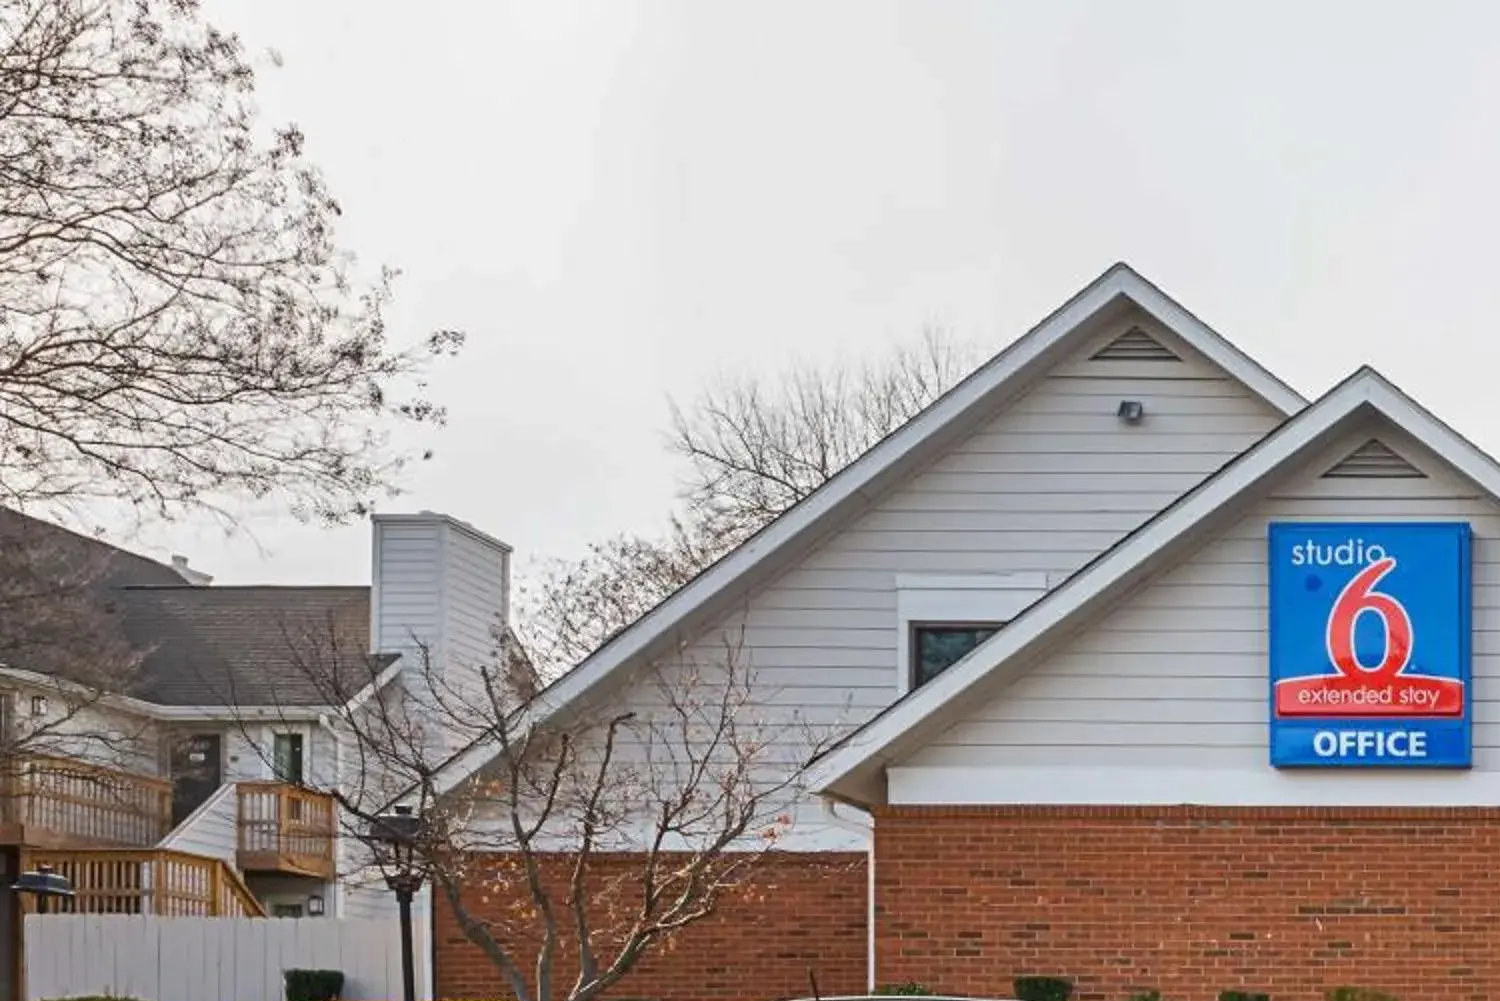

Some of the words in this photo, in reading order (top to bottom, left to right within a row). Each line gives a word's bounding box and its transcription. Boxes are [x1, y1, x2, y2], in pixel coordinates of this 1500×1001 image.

[1291, 539, 1386, 566] studio
[1325, 557, 1414, 676] 6
[1298, 686, 1393, 705] extended
[1399, 686, 1441, 709] stay
[1313, 731, 1428, 758] OFFICE
